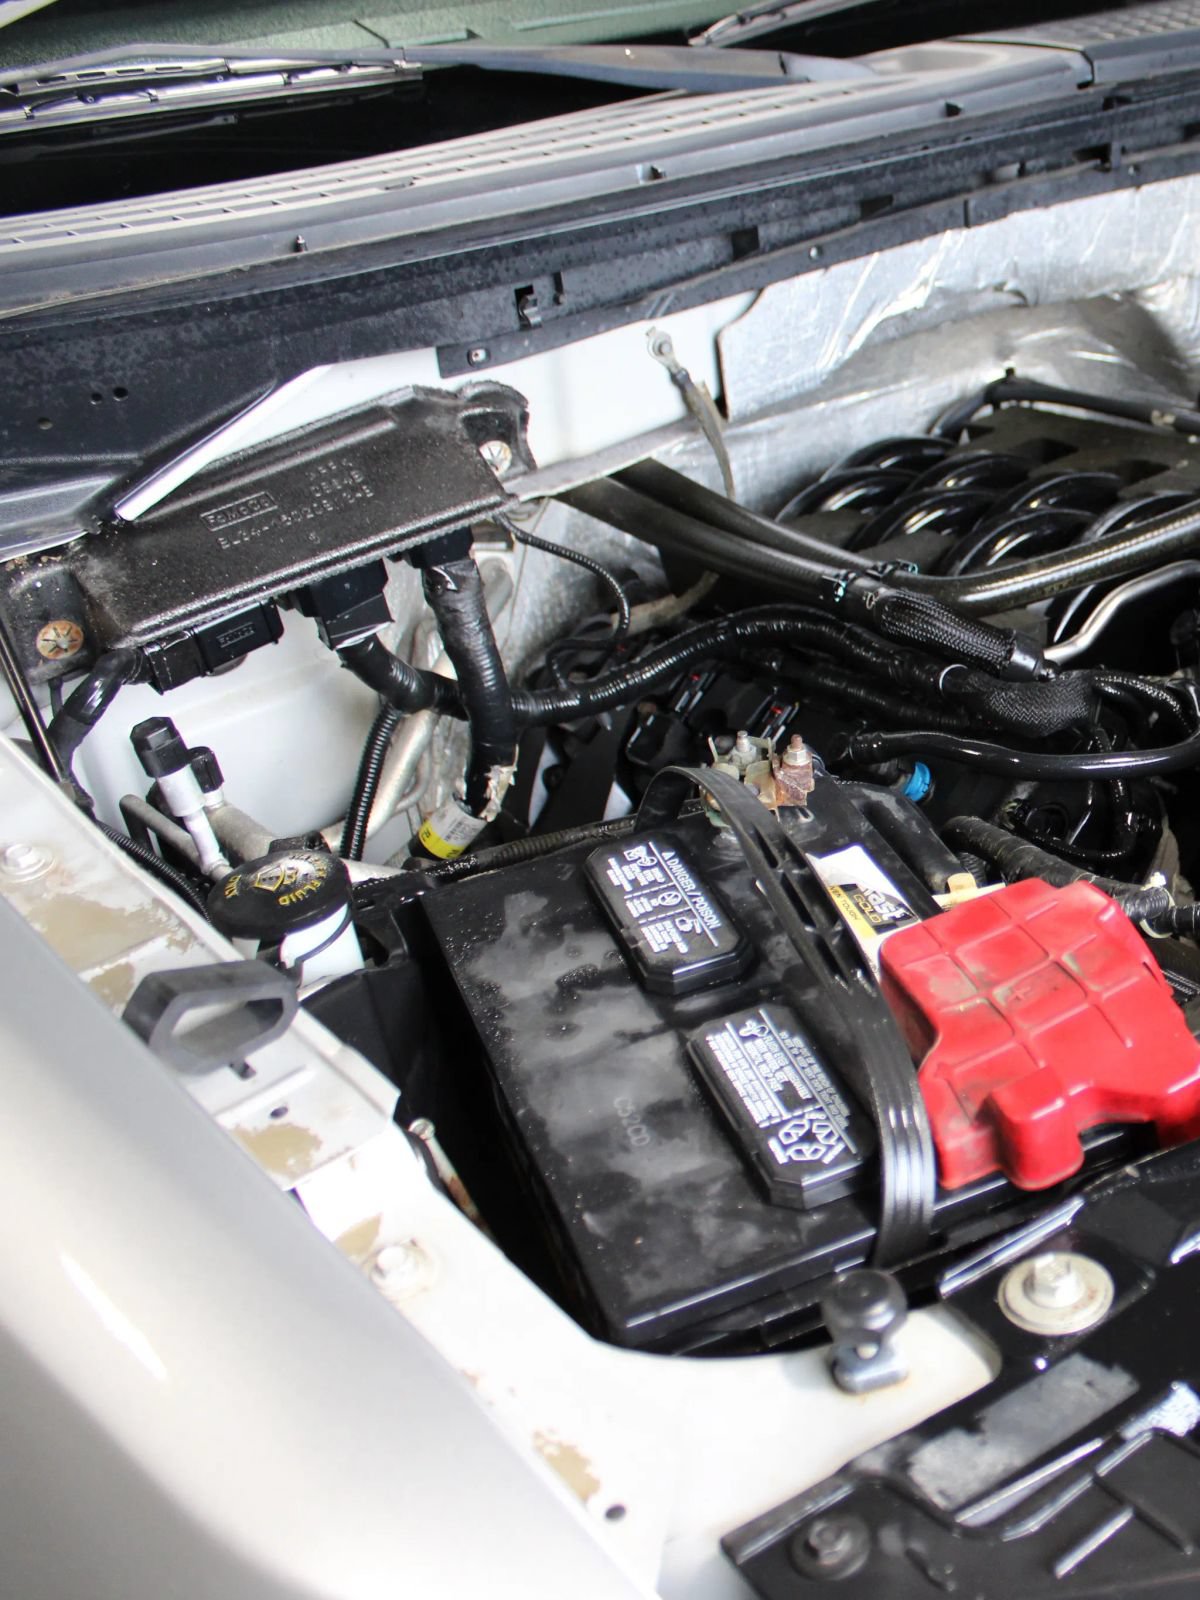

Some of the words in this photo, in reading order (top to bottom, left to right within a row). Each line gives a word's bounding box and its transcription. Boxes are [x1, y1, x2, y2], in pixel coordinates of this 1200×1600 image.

[278, 879, 321, 906] FLUID
[666, 858, 696, 891] DANGER
[691, 896, 721, 928] POISON
[852, 892, 882, 924] GOLD
